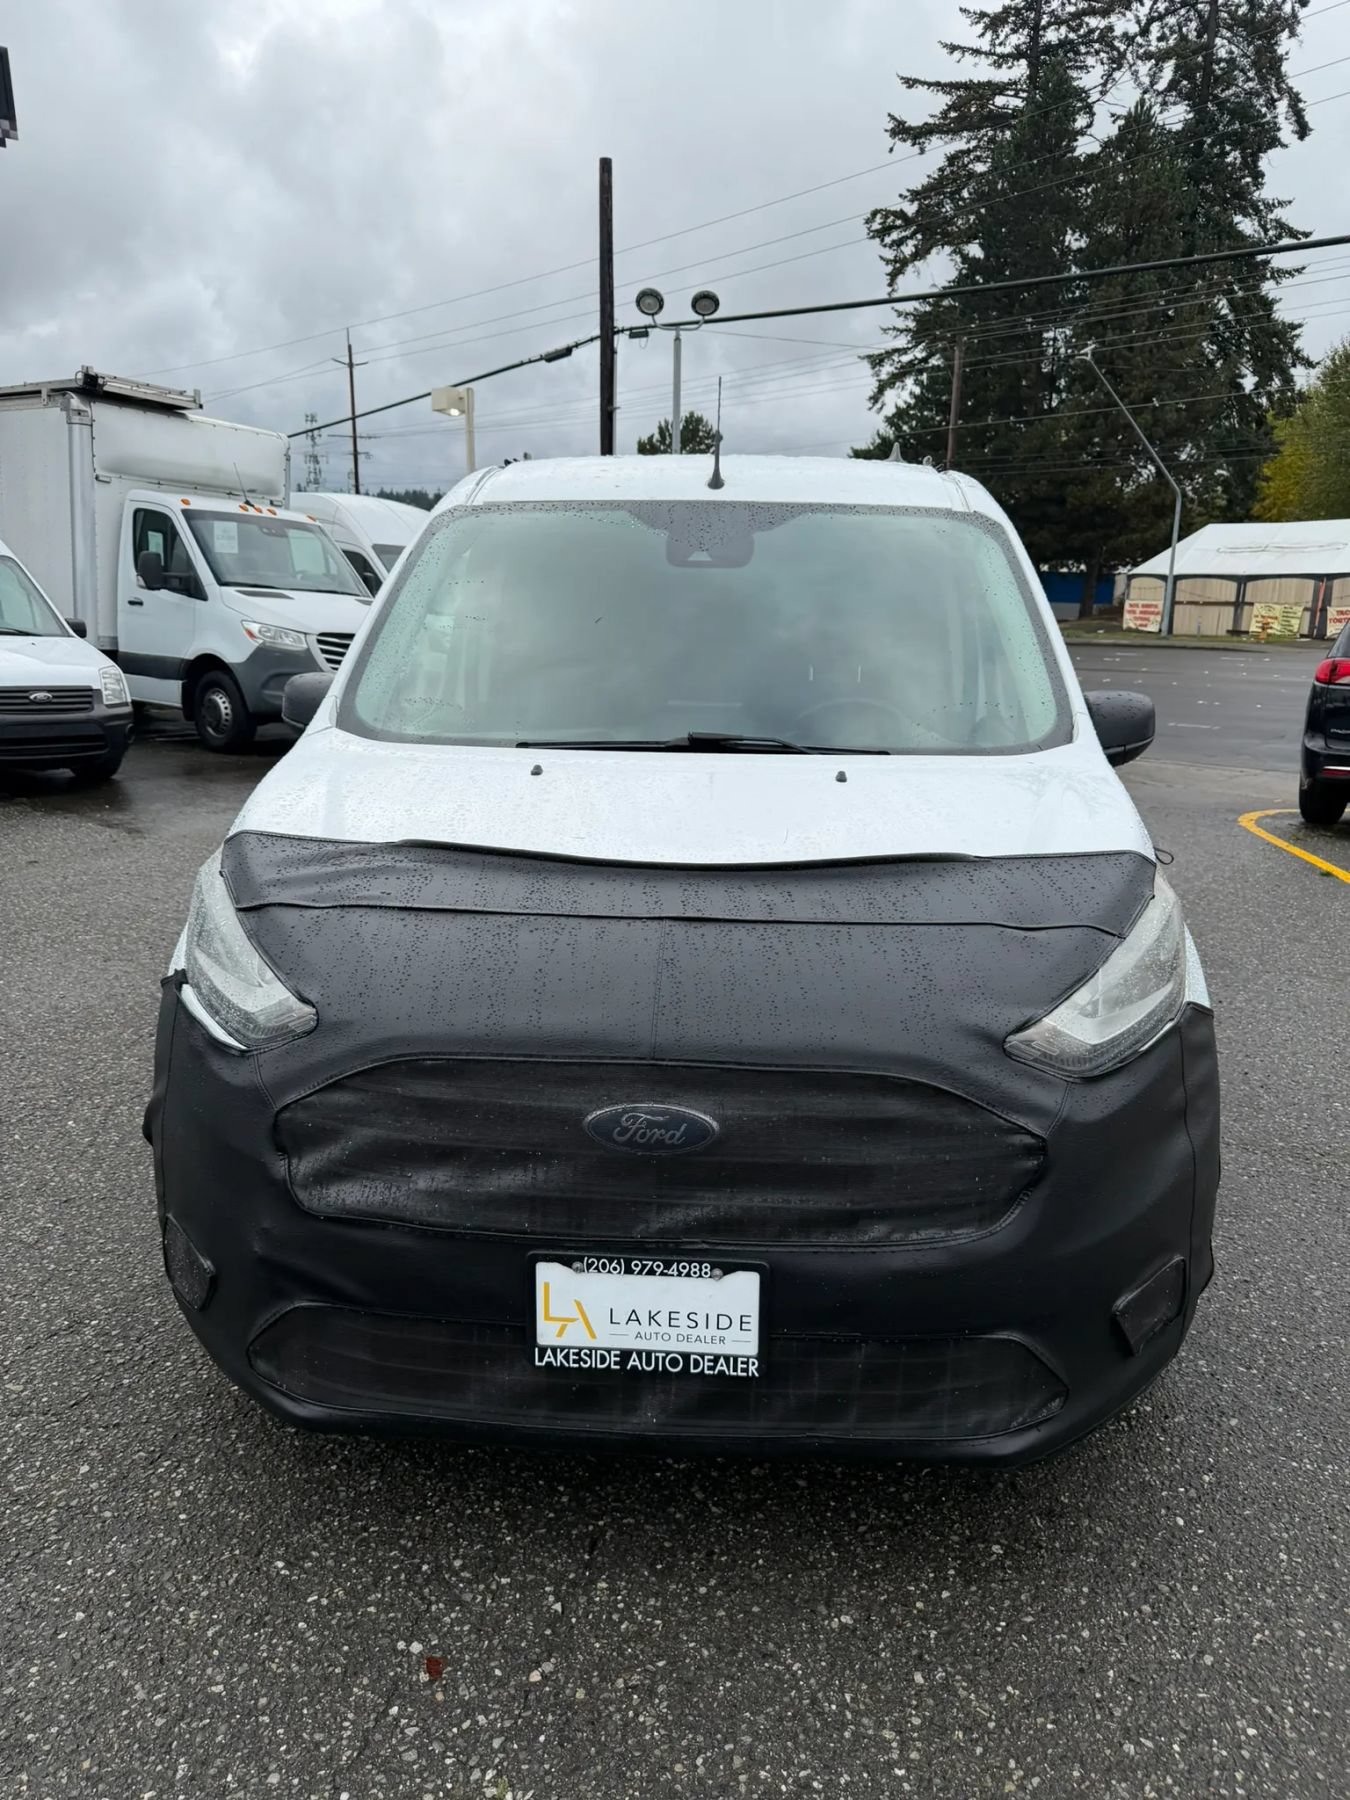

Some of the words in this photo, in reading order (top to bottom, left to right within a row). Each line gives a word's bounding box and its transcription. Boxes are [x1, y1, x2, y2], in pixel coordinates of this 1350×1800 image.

[612, 1112, 688, 1144] Ford
[583, 1256, 625, 1275] (206)
[631, 1260, 711, 1278] 979-4988
[609, 1307, 752, 1332] LAKESIDE
[634, 1331, 671, 1342] AUTO
[676, 1333, 726, 1345] DEALER
[535, 1347, 620, 1369] LAKESIDE
[627, 1351, 683, 1372] AUTO
[690, 1354, 759, 1377] DEALER
